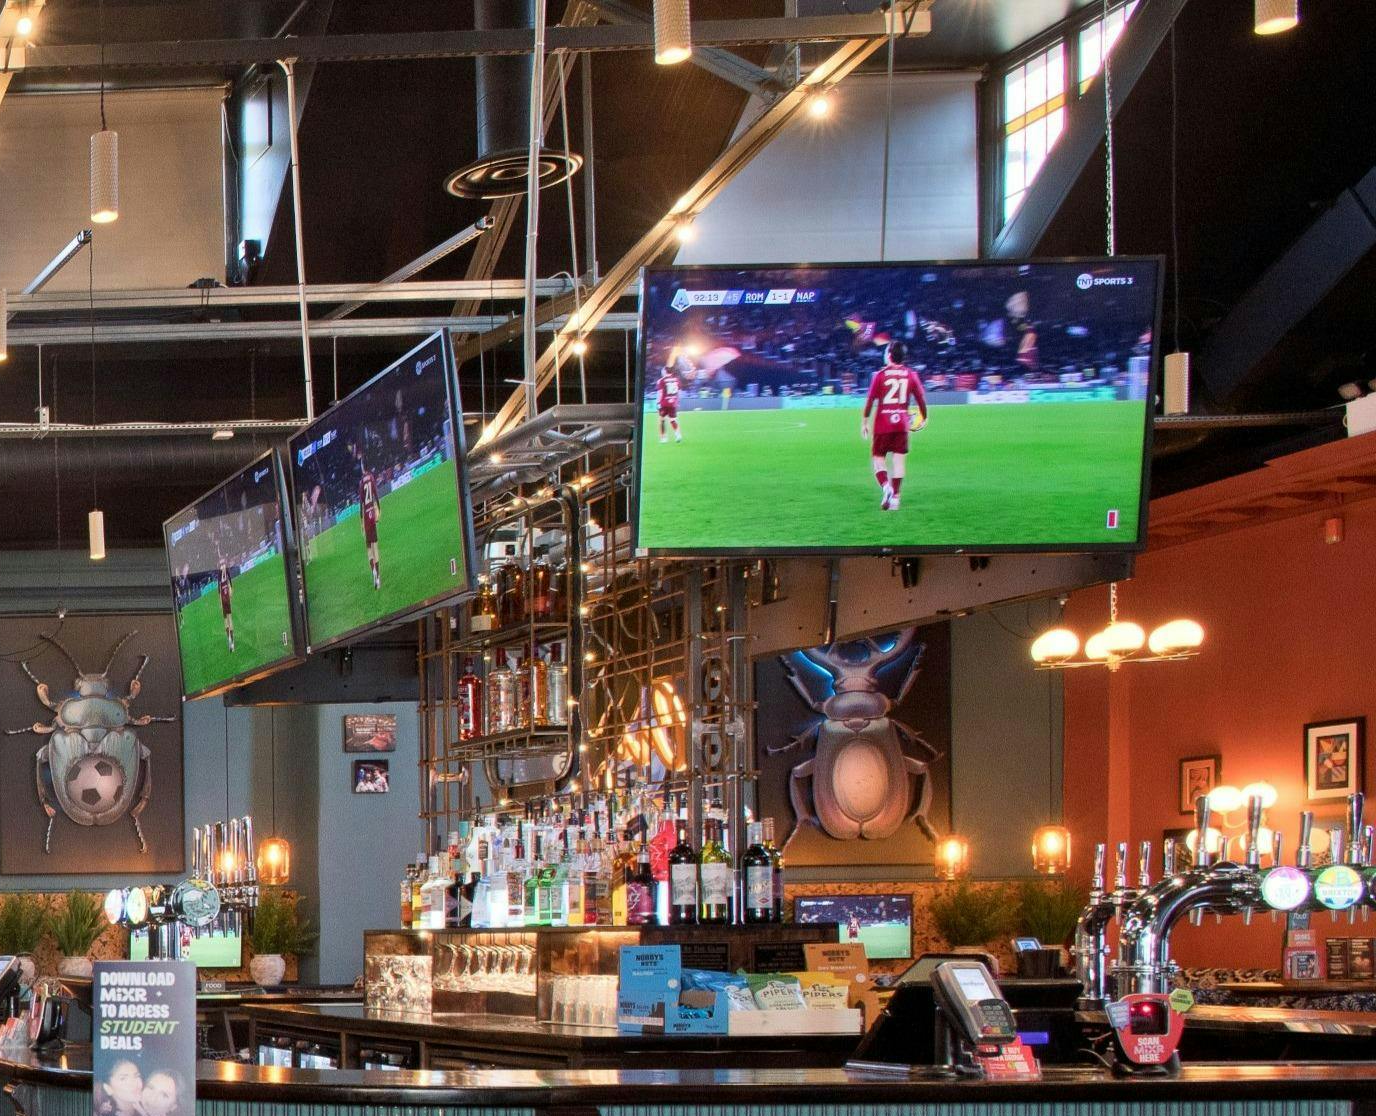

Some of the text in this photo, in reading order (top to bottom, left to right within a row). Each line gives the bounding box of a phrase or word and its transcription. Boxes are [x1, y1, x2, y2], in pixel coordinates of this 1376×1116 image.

[1094, 277, 1126, 285] SPORTS
[1128, 277, 1133, 285] 3
[694, 294, 719, 302] 92:13
[797, 292, 815, 300] NAP
[882, 379, 909, 404] 21
[636, 953, 664, 961] NOBBY'S
[100, 972, 175, 986] DOWNLOAD
[803, 990, 844, 998] PIPERS
[100, 1004, 170, 1018] TO ACCESS
[100, 1021, 180, 1034] STUDENT
[100, 1036, 143, 1049] DEALS
[1137, 1037, 1160, 1046] SCAN
[1139, 1054, 1160, 1063] HERE
